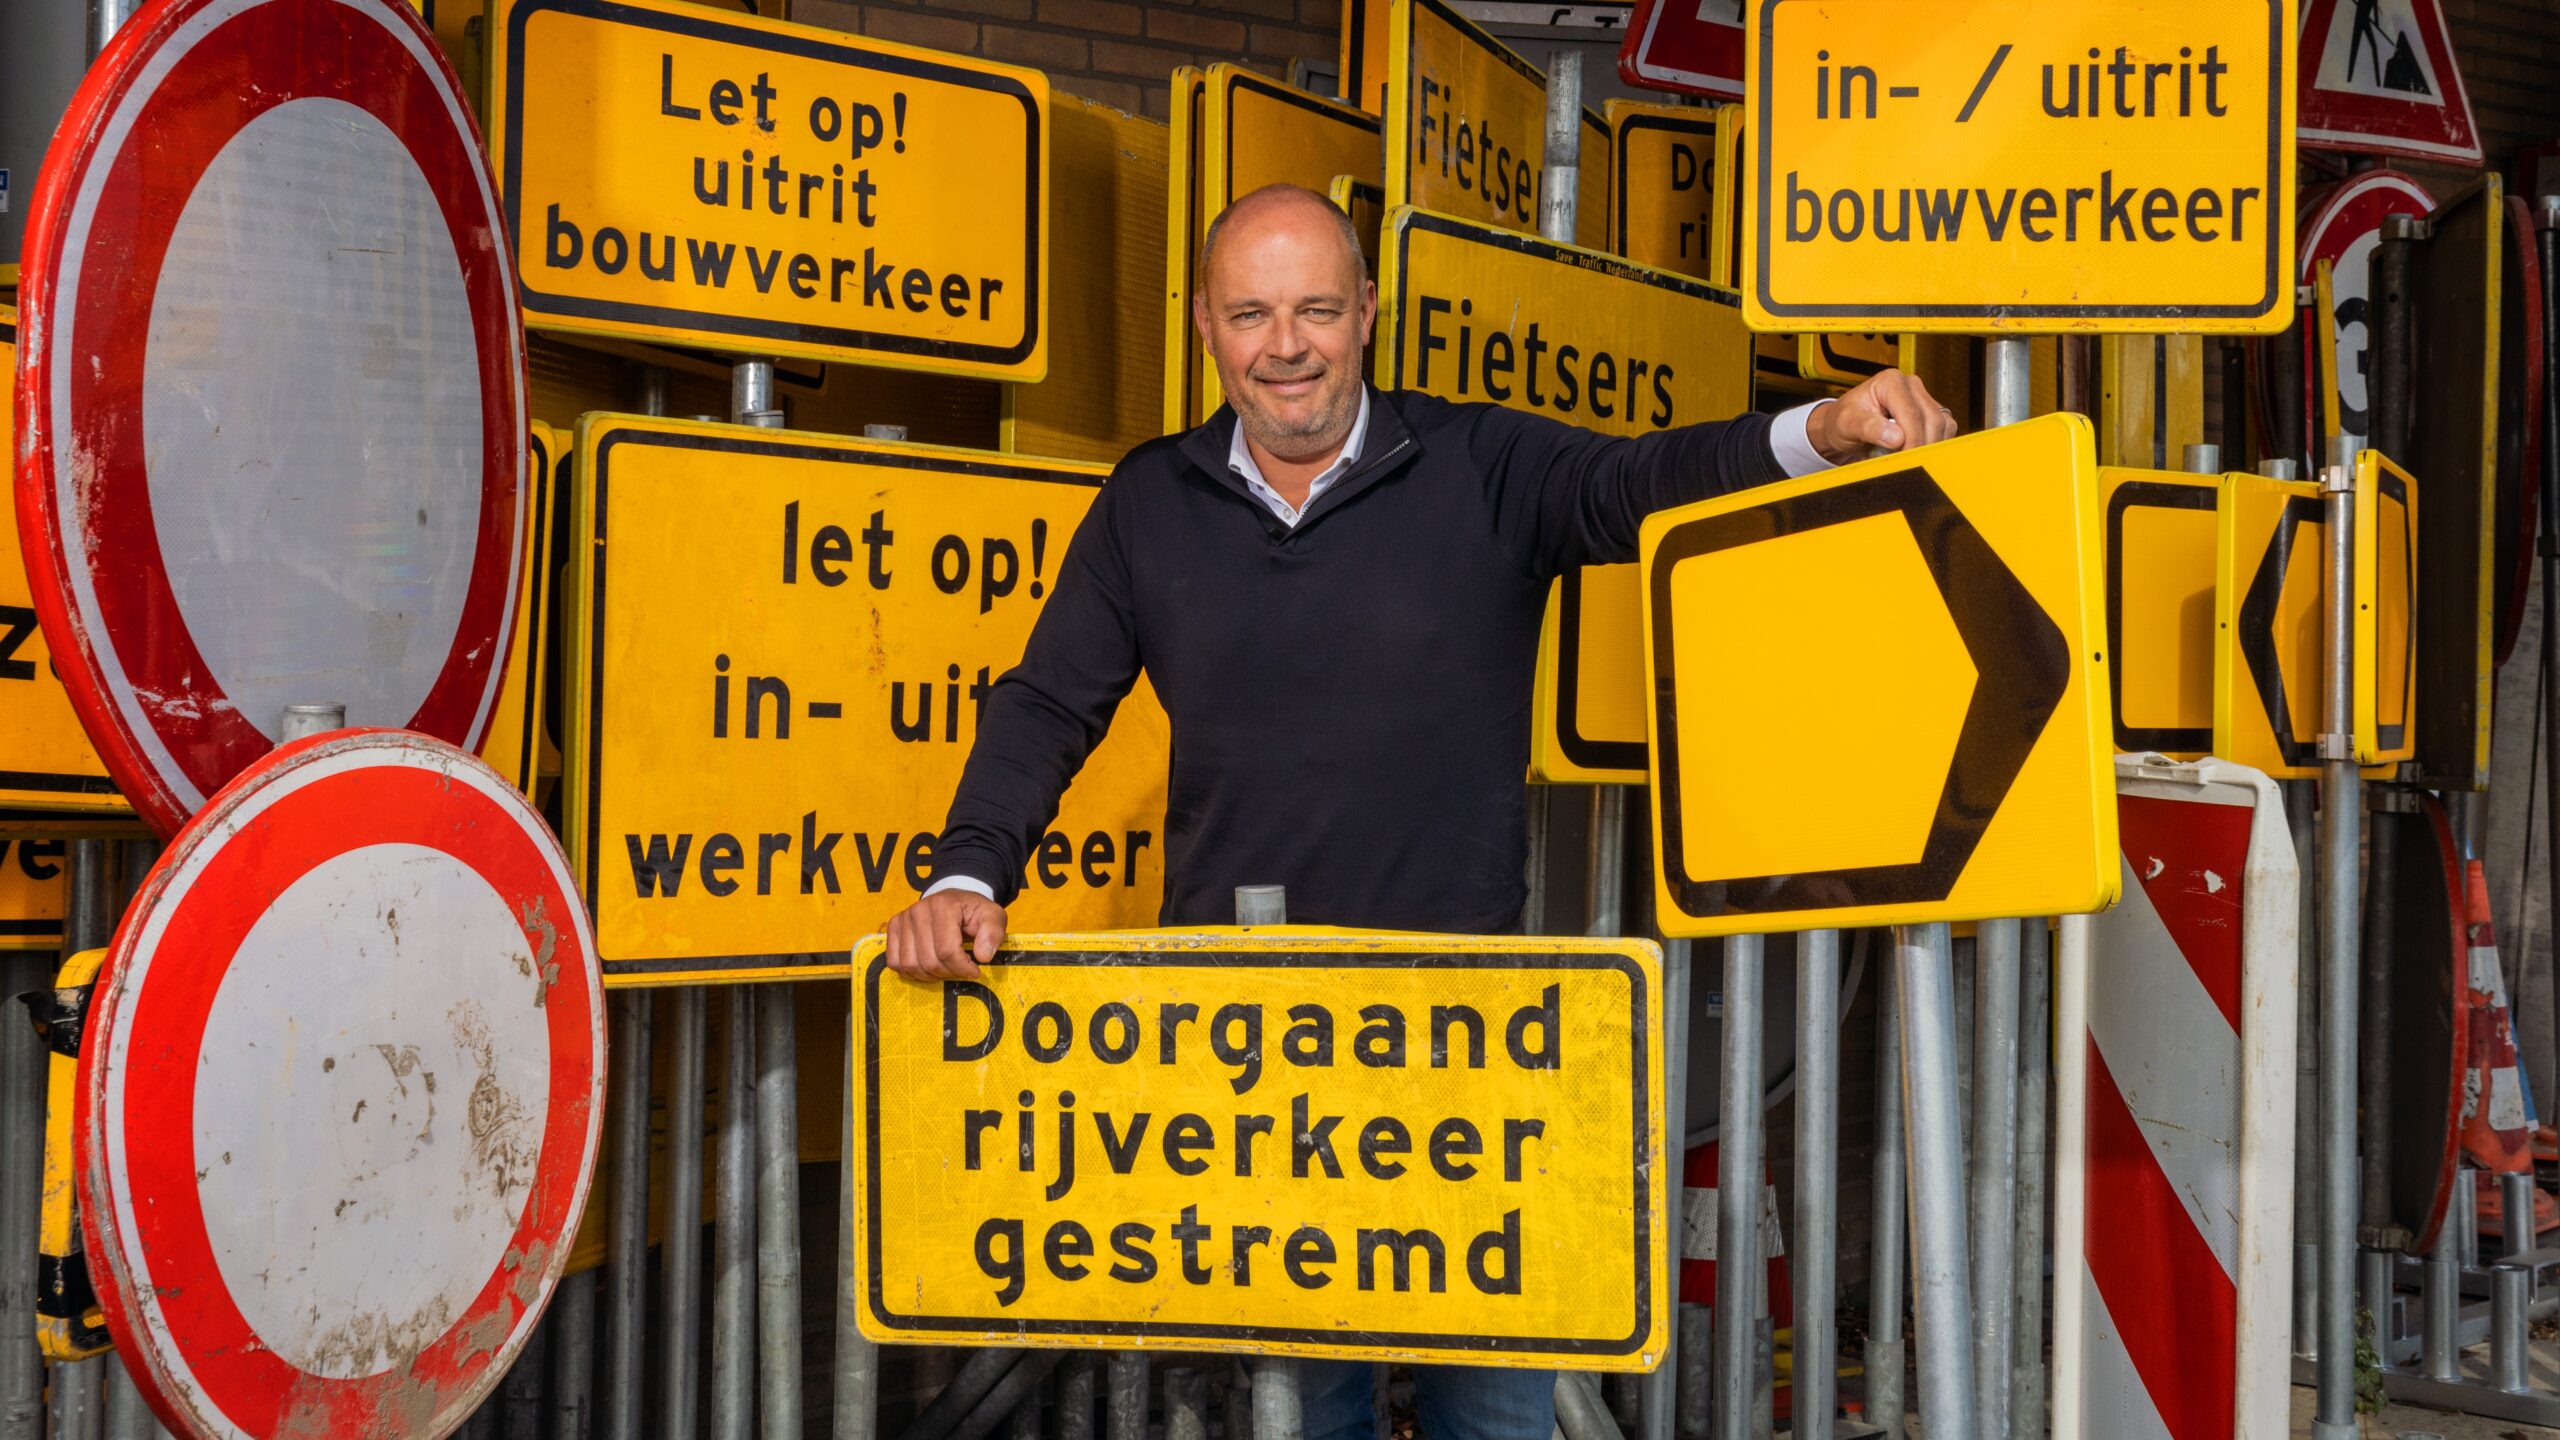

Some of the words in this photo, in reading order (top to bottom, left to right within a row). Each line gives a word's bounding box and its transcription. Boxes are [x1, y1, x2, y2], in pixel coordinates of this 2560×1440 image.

[662, 54, 777, 132] Let
[810, 93, 907, 160] op!
[1818, 50, 1919, 119] in-
[1955, 44, 2013, 122] /
[2043, 46, 2227, 118] uitrit
[694, 150, 877, 228] uitrit
[1786, 170, 2260, 242] bouwverkeer
[547, 204, 1003, 322] bouwverkeer
[1555, 248, 1574, 265] Save
[1417, 296, 1674, 429] Fietsers
[784, 502, 893, 590] let
[932, 519, 1047, 615] op!
[715, 654, 842, 739] in-
[626, 812, 1152, 899] werkveeer
[943, 980, 1561, 1095] Doorgaand
[965, 1090, 1545, 1201] rijverkeer
[975, 1205, 1521, 1307] gestremd
